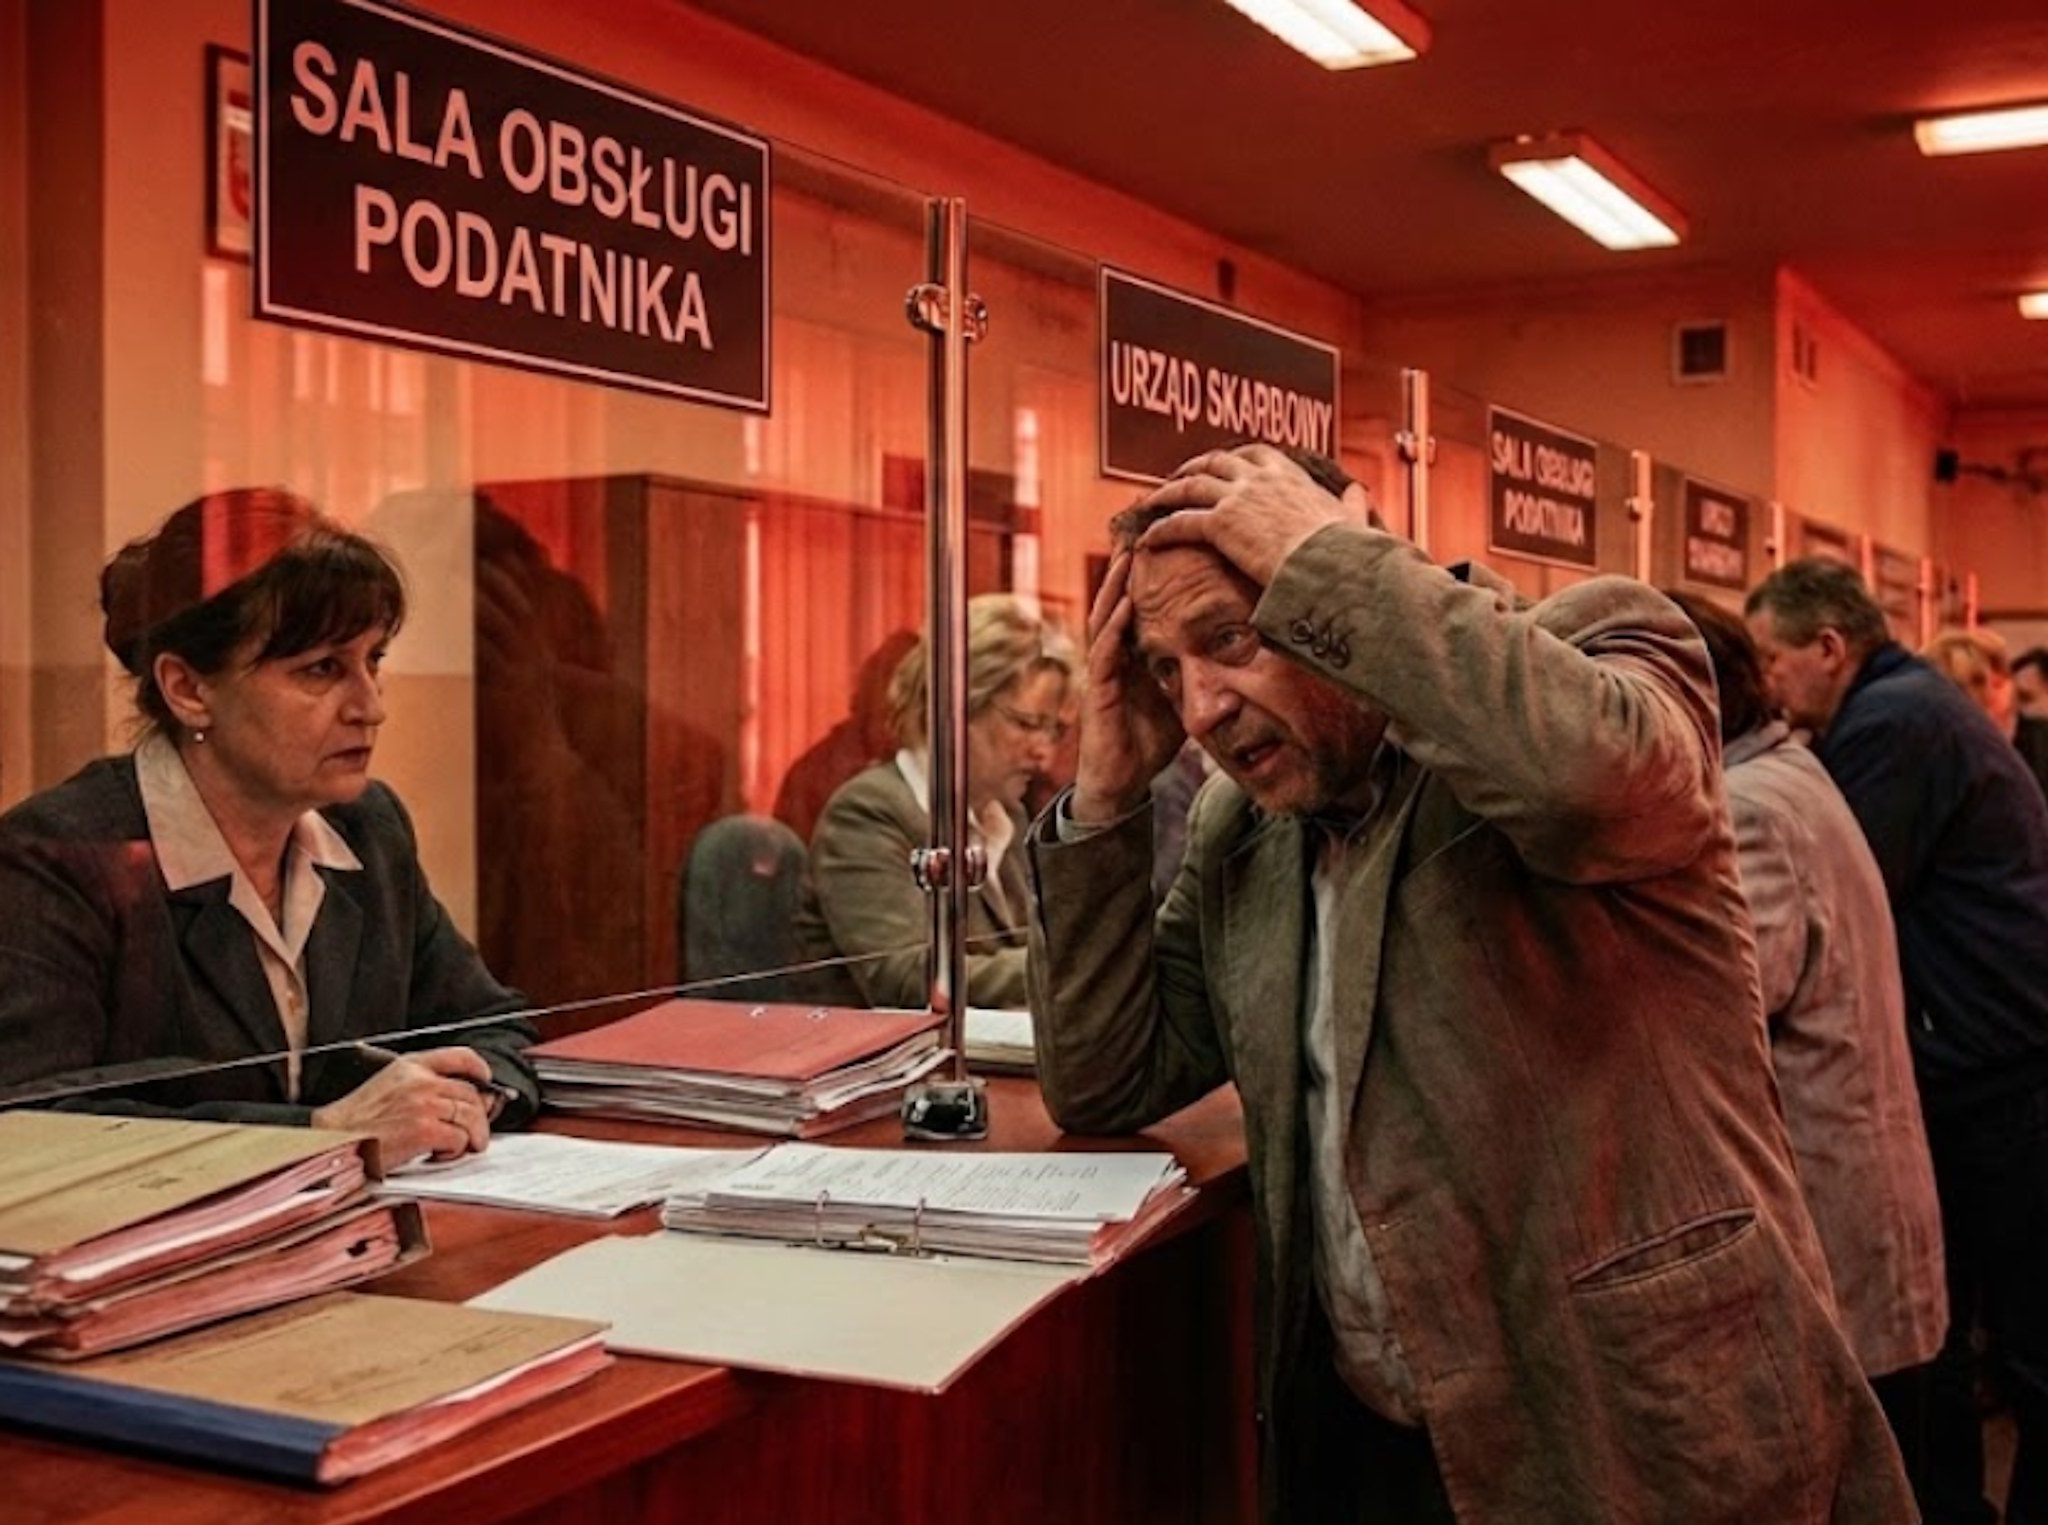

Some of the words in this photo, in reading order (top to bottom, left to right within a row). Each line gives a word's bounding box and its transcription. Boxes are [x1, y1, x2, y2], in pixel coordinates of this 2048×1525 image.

[290, 40, 484, 180] SALA
[499, 108, 753, 256] OBSŁUGI
[354, 183, 714, 350] PODATNIKA
[1111, 339, 1200, 433] URZĄD
